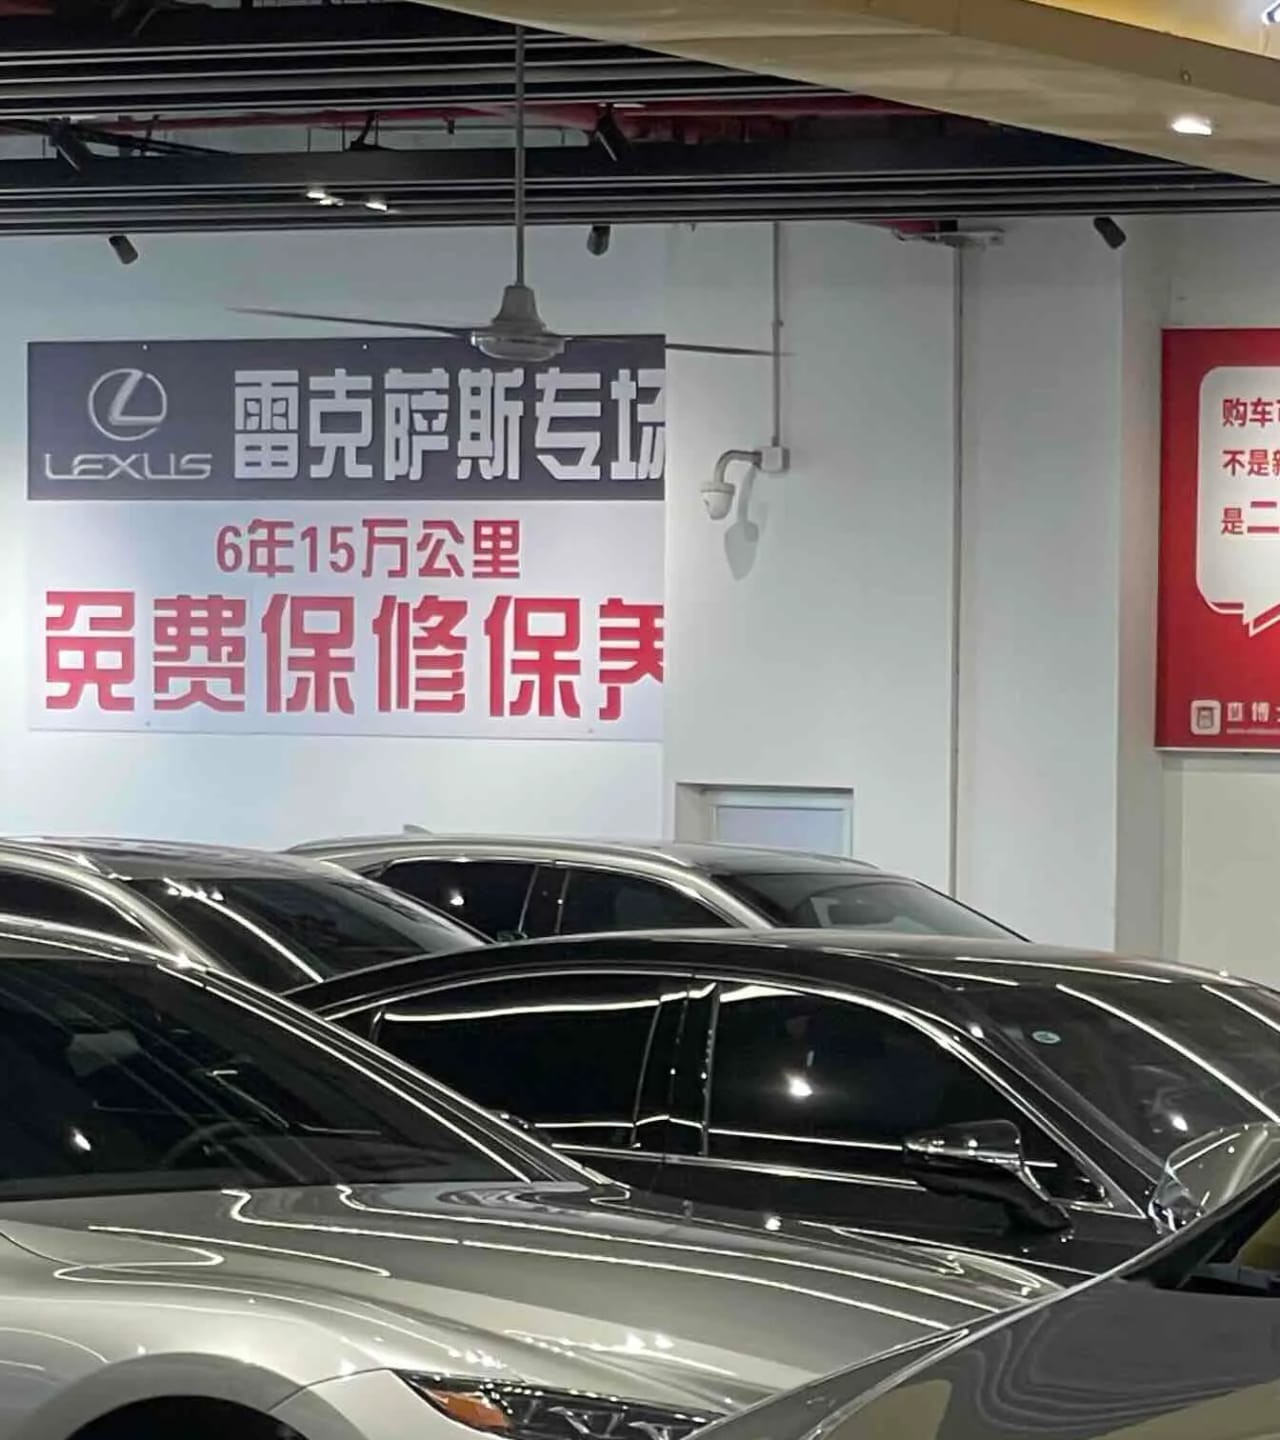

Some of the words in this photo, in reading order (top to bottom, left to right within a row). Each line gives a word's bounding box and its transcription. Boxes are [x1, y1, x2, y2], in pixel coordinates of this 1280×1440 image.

[234, 367, 665, 481] 雷克萨斯专场
[44, 453, 213, 480] LEXUS
[216, 518, 520, 579] 6年15万公里
